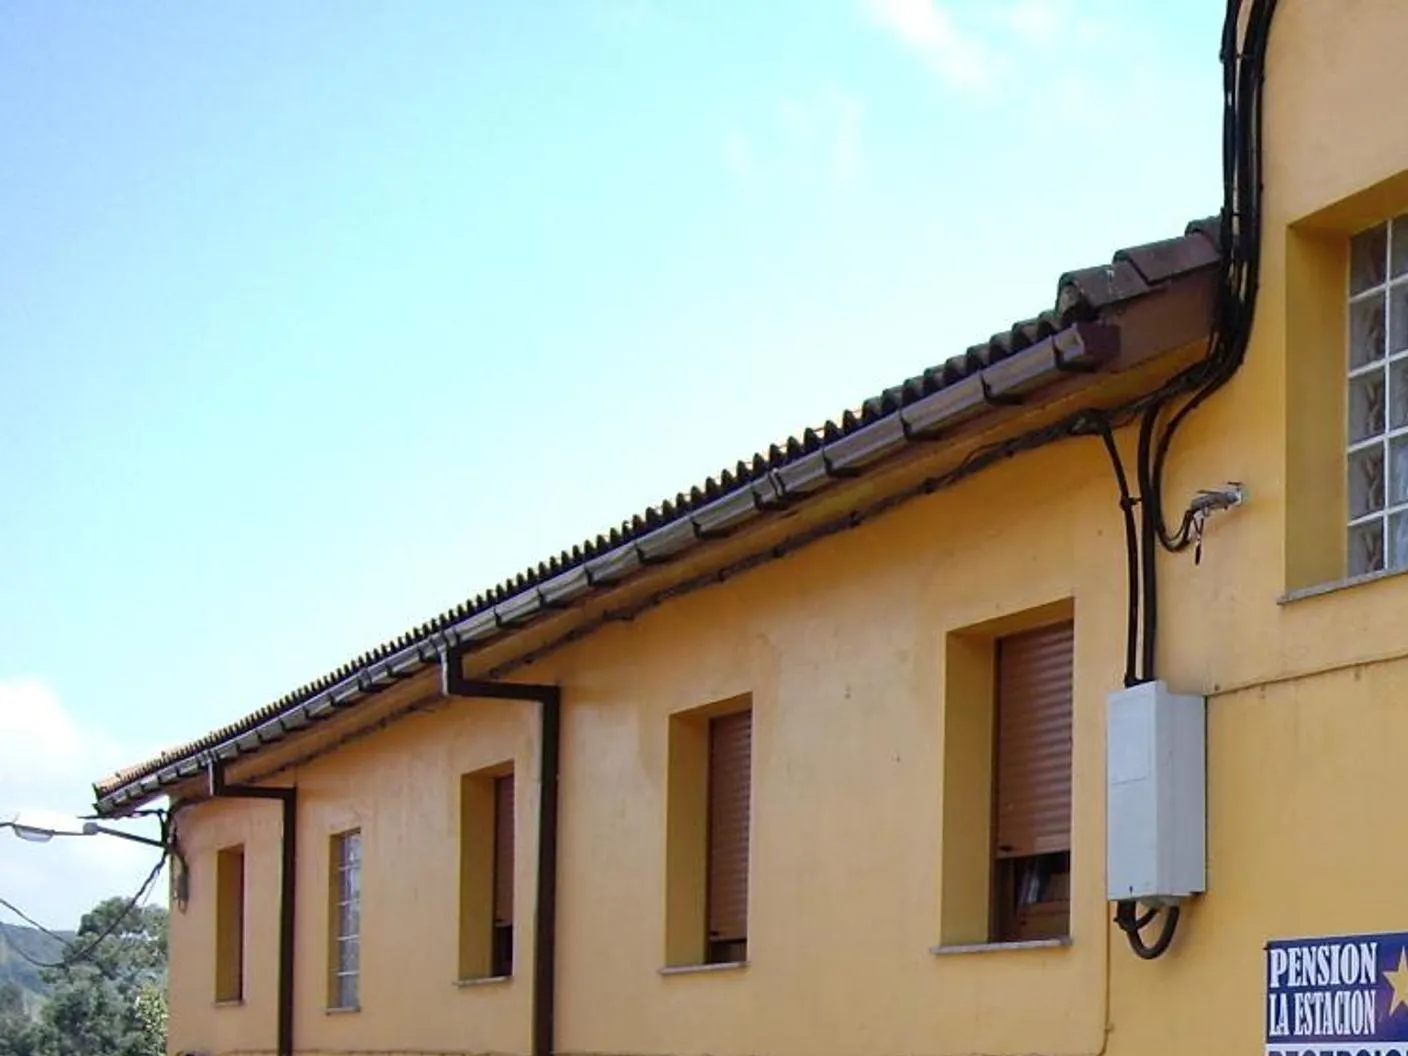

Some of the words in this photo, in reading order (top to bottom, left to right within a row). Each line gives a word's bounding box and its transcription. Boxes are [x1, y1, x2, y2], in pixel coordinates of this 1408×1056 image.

[1269, 942, 1378, 988] PENSION
[1269, 993, 1289, 1036] LA
[1294, 990, 1376, 1036] ESTACION
